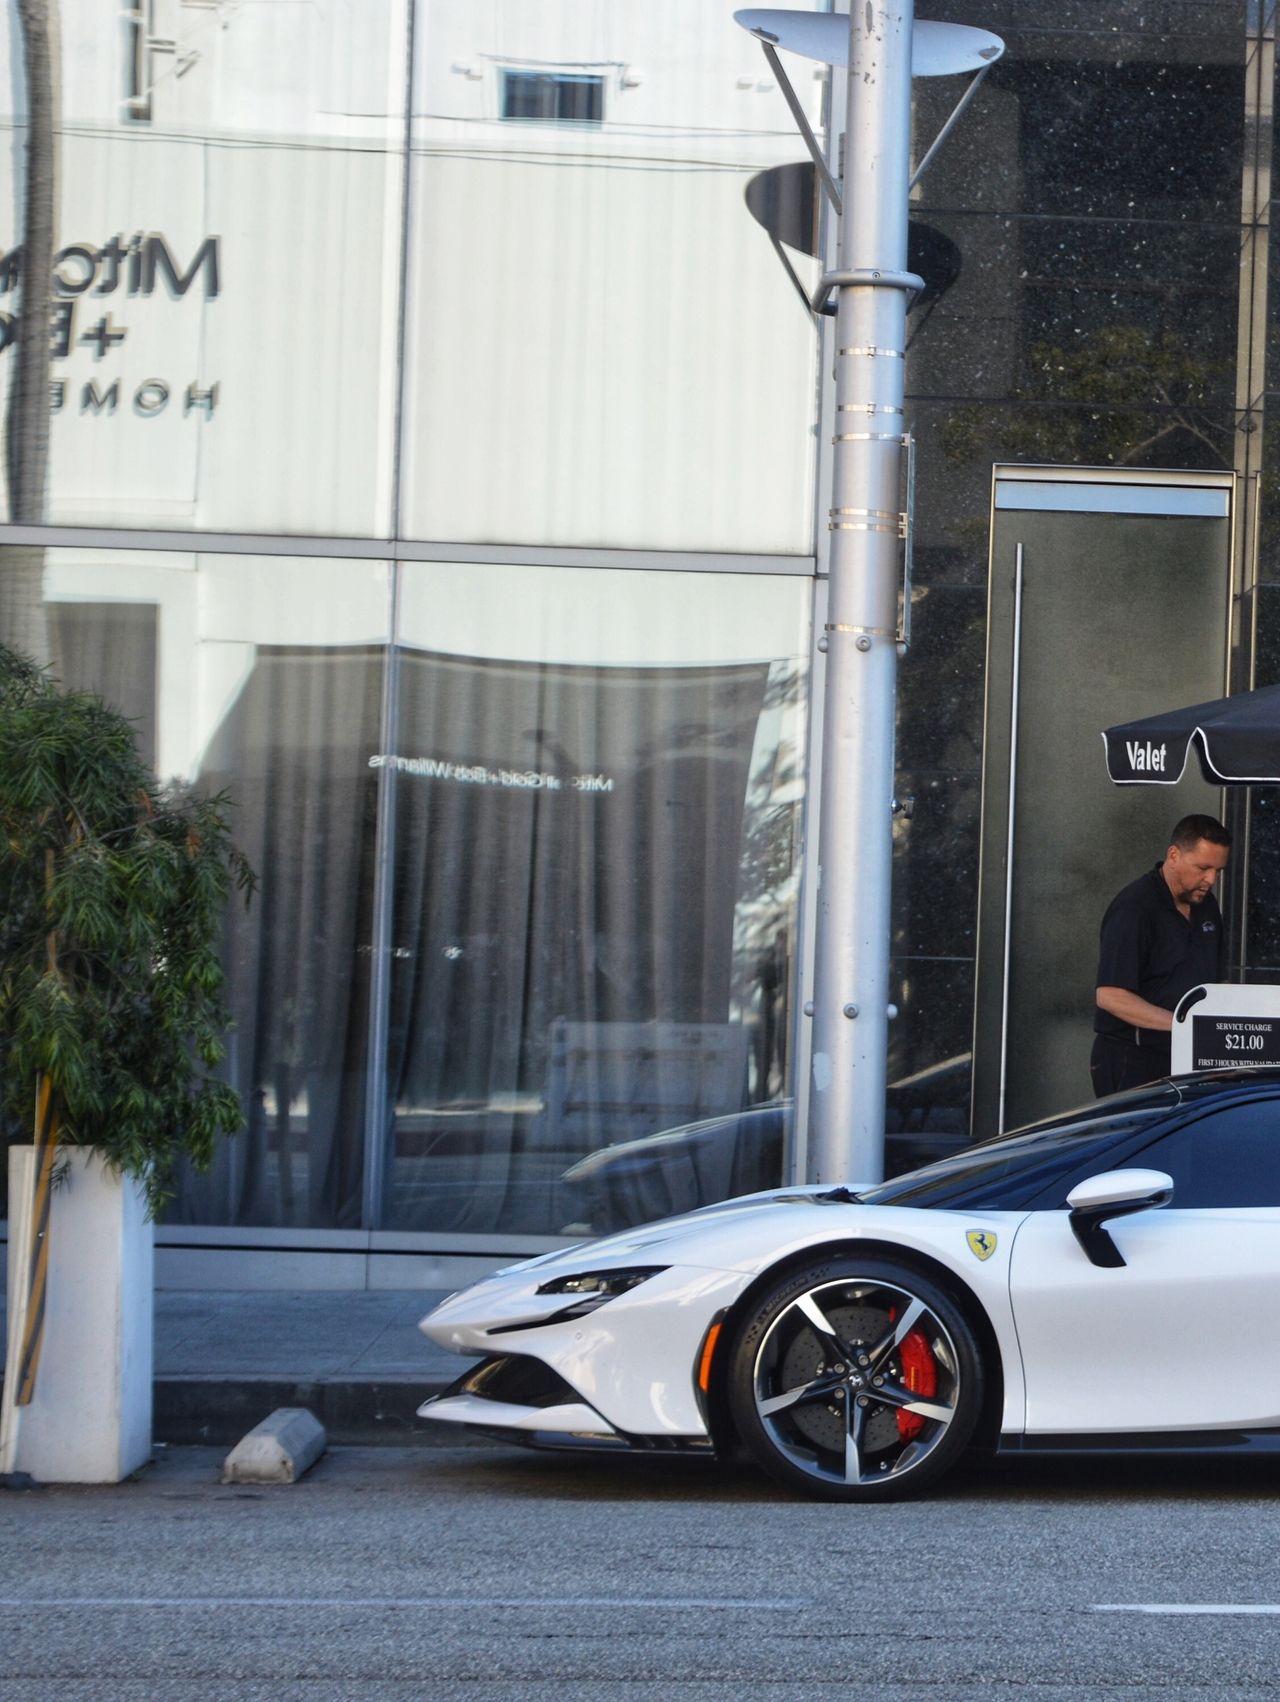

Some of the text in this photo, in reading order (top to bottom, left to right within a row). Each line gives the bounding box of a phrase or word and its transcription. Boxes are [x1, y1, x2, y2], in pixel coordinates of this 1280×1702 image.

[1125, 741, 1167, 772] Valet
[1215, 1022, 1273, 1032] SERVICE CHARGE
[1225, 1033, 1265, 1051] $21.00
[1198, 1058, 1214, 1067] FIRST
[1214, 1059, 1219, 1067] 3
[1219, 1059, 1239, 1067] HOURS
